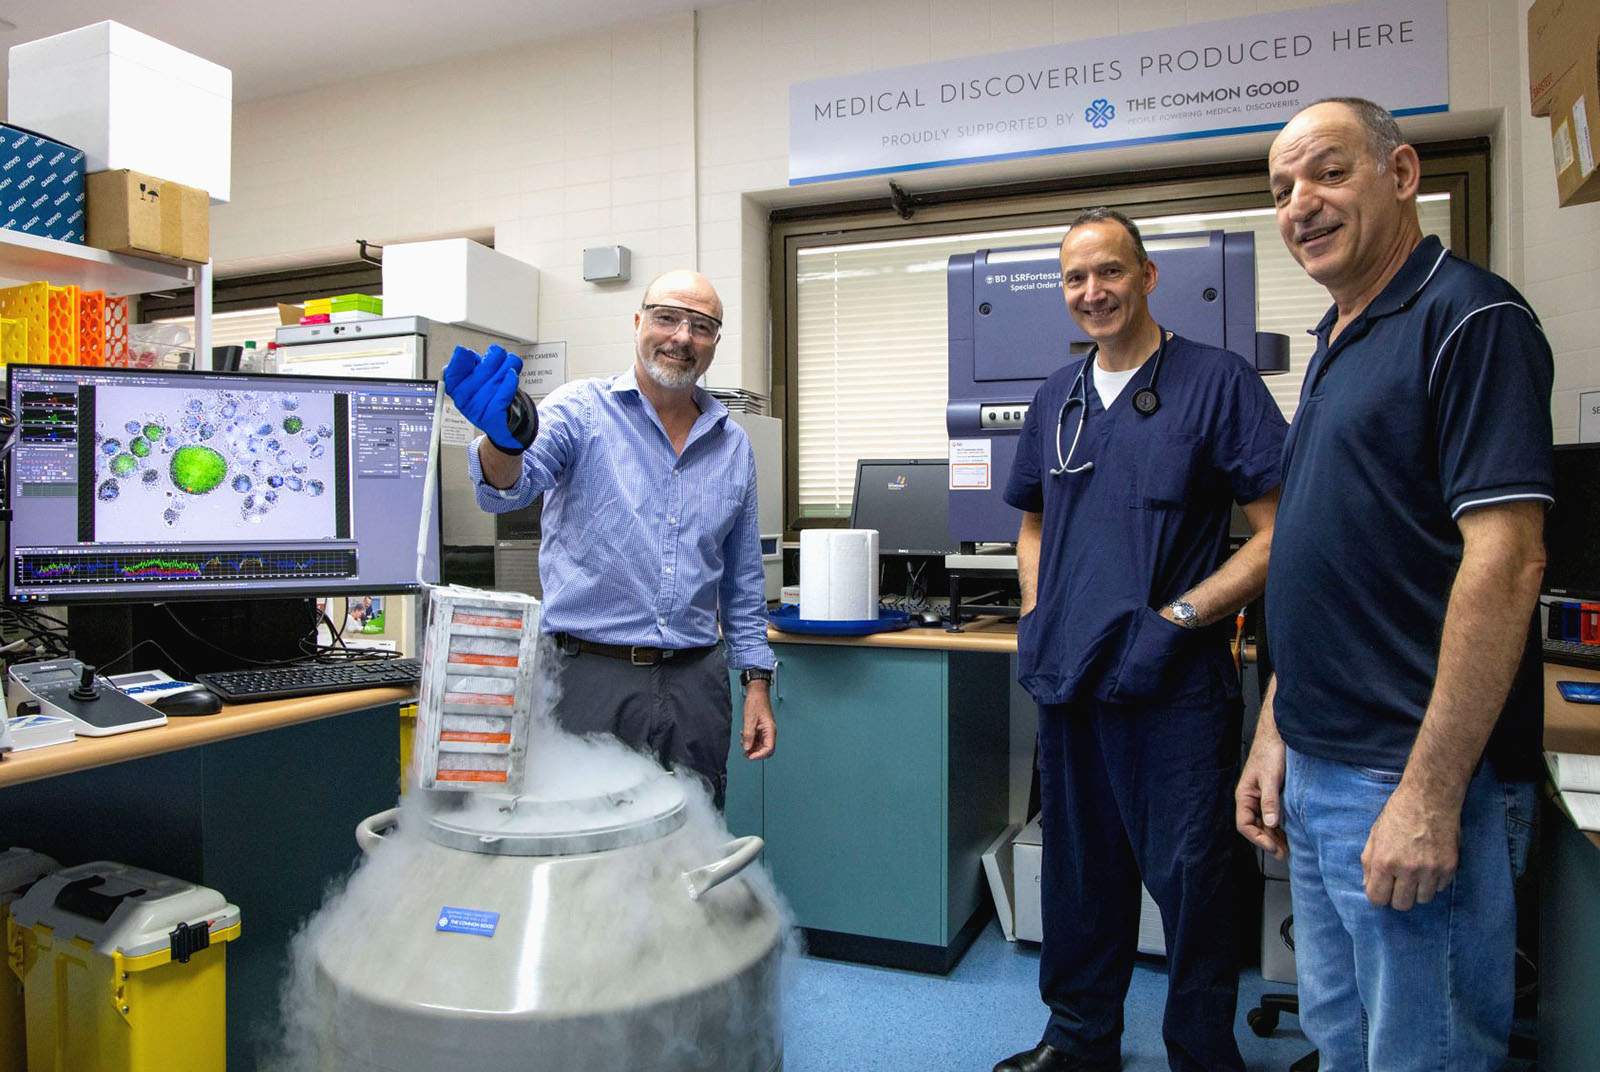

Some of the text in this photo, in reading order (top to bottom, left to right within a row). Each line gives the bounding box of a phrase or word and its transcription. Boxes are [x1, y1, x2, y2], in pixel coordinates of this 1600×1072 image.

[814, 20, 1414, 121] MEDICAL DISCOVERIES PRODUCED HERE
[1126, 79, 1299, 112] THE COMMON GOOD
[1159, 109, 1203, 121] POWERING
[1206, 106, 1242, 116] MEDICAL
[1246, 98, 1301, 112] DISCOVERIES
[882, 112, 1075, 147] PROUDLY SUPPORTED BY
[3, 155, 21, 171] QIAGEN
[27, 153, 44, 169] QIAGEN
[18, 175, 35, 190] QIAGEN
[41, 172, 58, 188] QIAGEN
[8, 196, 26, 212] QIAGEN
[32, 194, 49, 209] QIAGEN
[54, 191, 71, 206] QIAGEN
[22, 215, 40, 231] QIAGEN
[44, 212, 62, 228] QIAGEN
[995, 272, 1061, 283] BD LSRFortessa
[1010, 283, 1035, 292] Special
